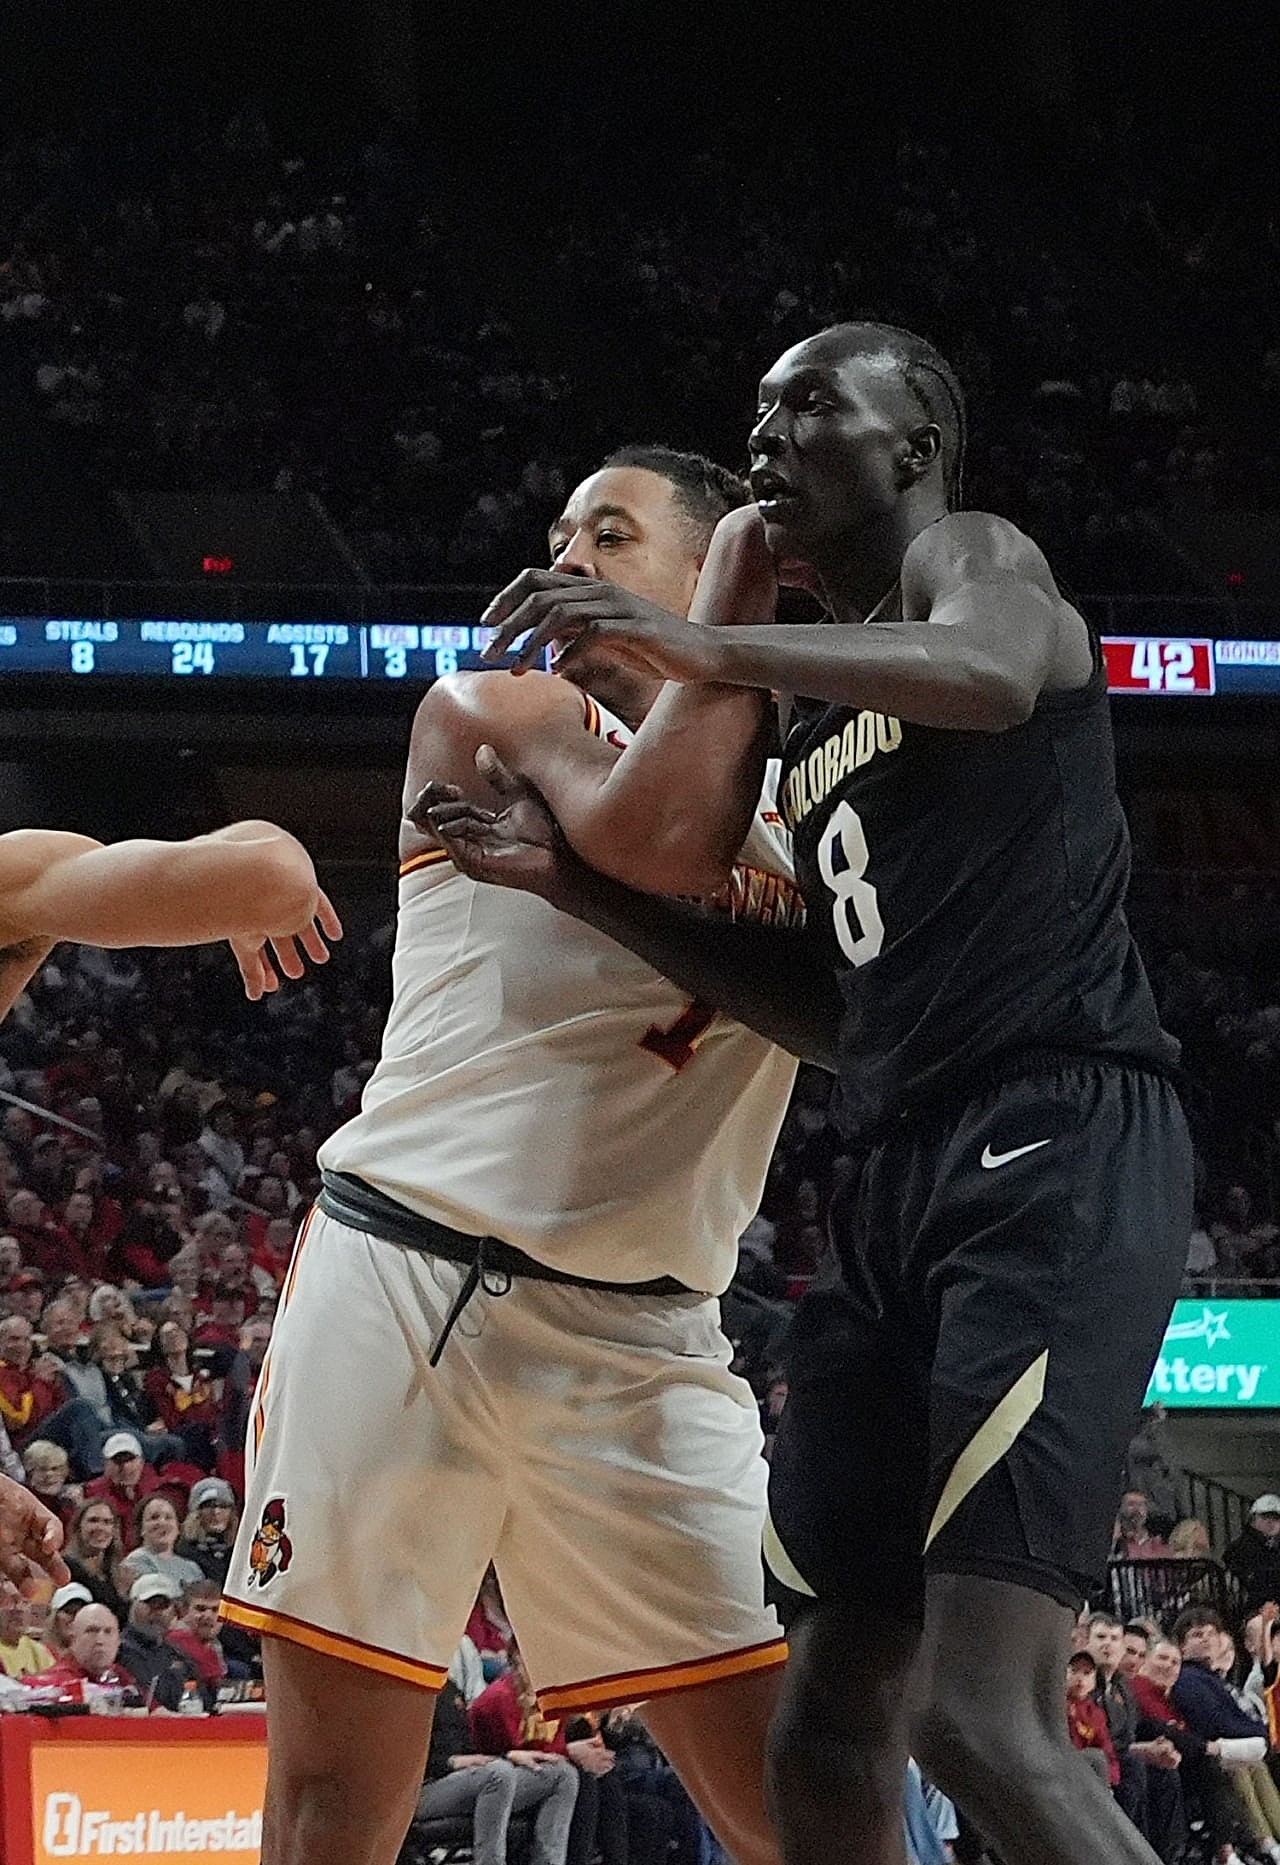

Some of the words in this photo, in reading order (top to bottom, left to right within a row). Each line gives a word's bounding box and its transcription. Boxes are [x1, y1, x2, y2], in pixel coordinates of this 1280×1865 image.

[45, 620, 119, 642] STEALS
[140, 620, 245, 643] REBOUNDS
[267, 623, 350, 645] ASSISTS
[70, 641, 95, 674] 8
[171, 641, 215, 675] 24
[289, 643, 330, 677] 17
[1131, 641, 1196, 692] 42
[783, 709, 903, 832] COLORADO
[819, 799, 885, 968] 8
[1154, 1356, 1263, 1400] ttery
[80, 1810, 146, 1856] First
[148, 1809, 263, 1854] Interstat
